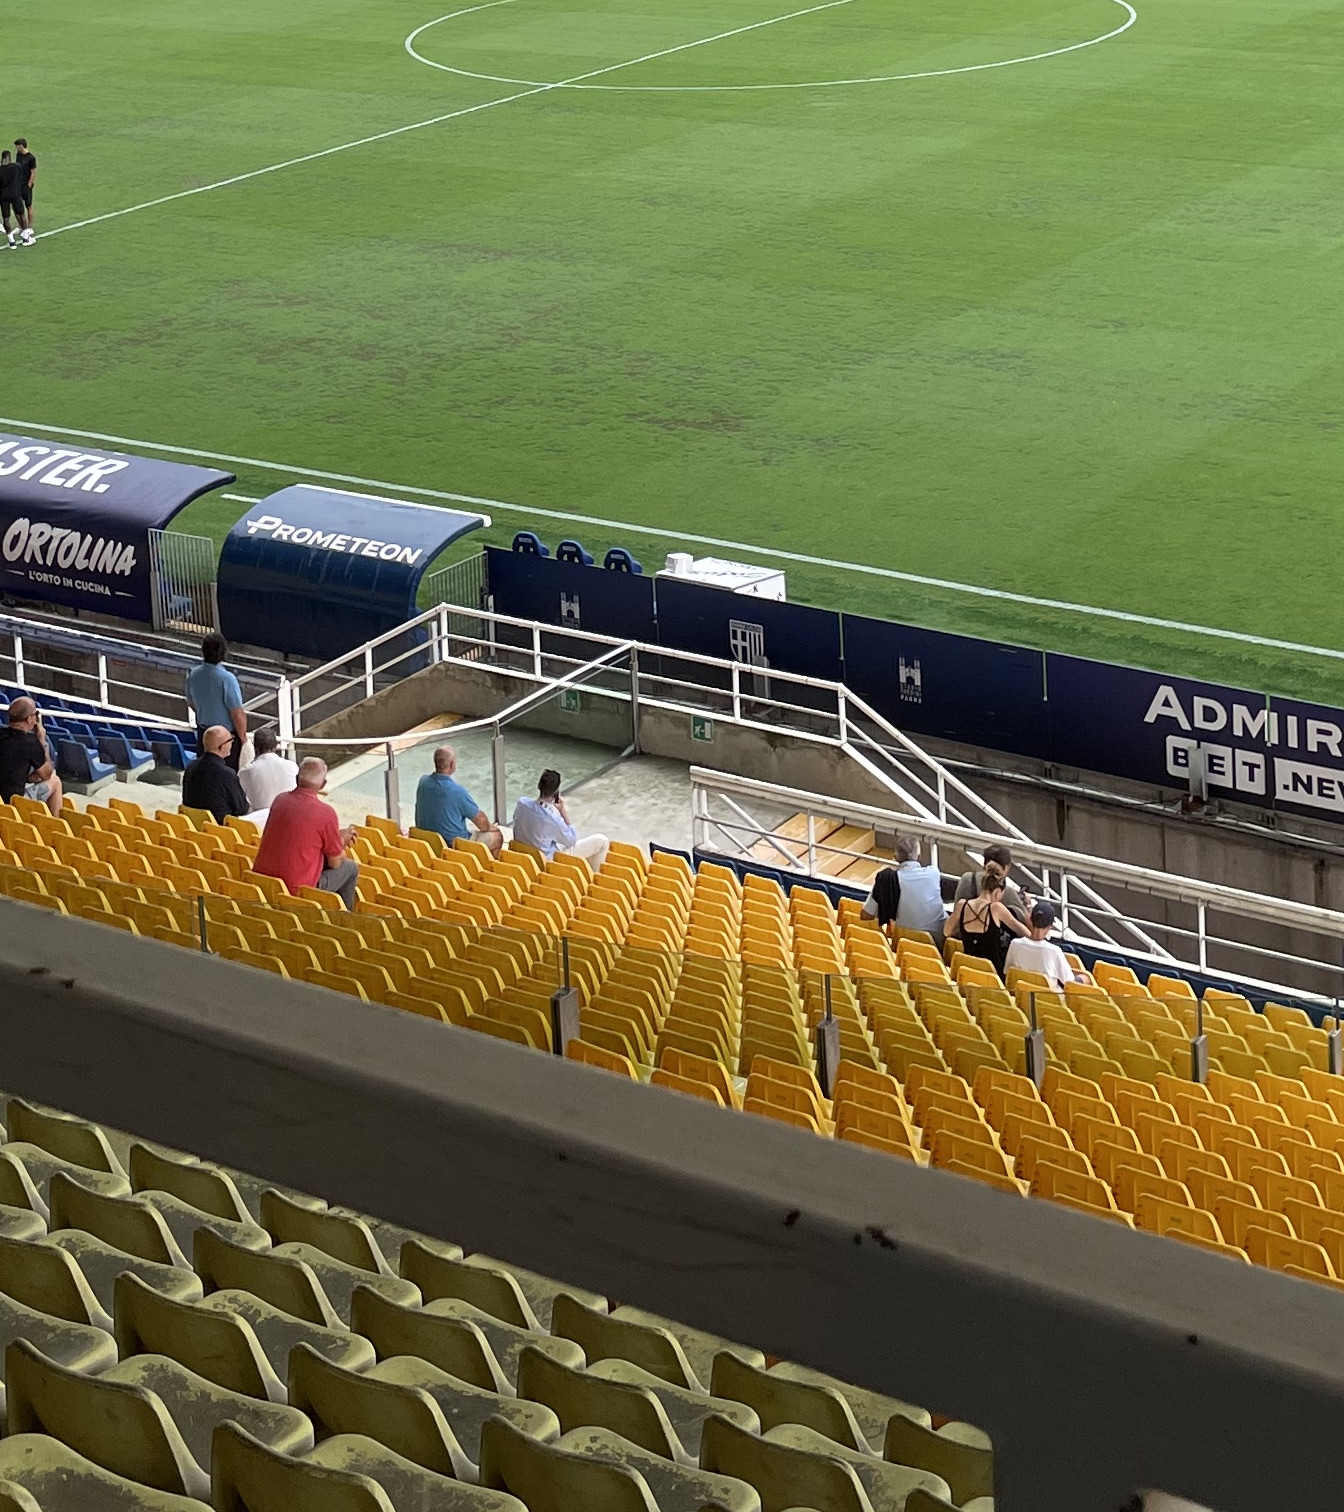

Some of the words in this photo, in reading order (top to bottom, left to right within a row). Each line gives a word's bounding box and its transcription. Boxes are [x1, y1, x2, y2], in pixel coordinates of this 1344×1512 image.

[3, 517, 137, 577] ORTOLINA
[247, 515, 423, 565] PROMETEON
[28, 569, 62, 586] L'ORTO
[62, 577, 73, 588] IN
[74, 580, 111, 596] CUCINA
[1172, 748, 1261, 783] BET
